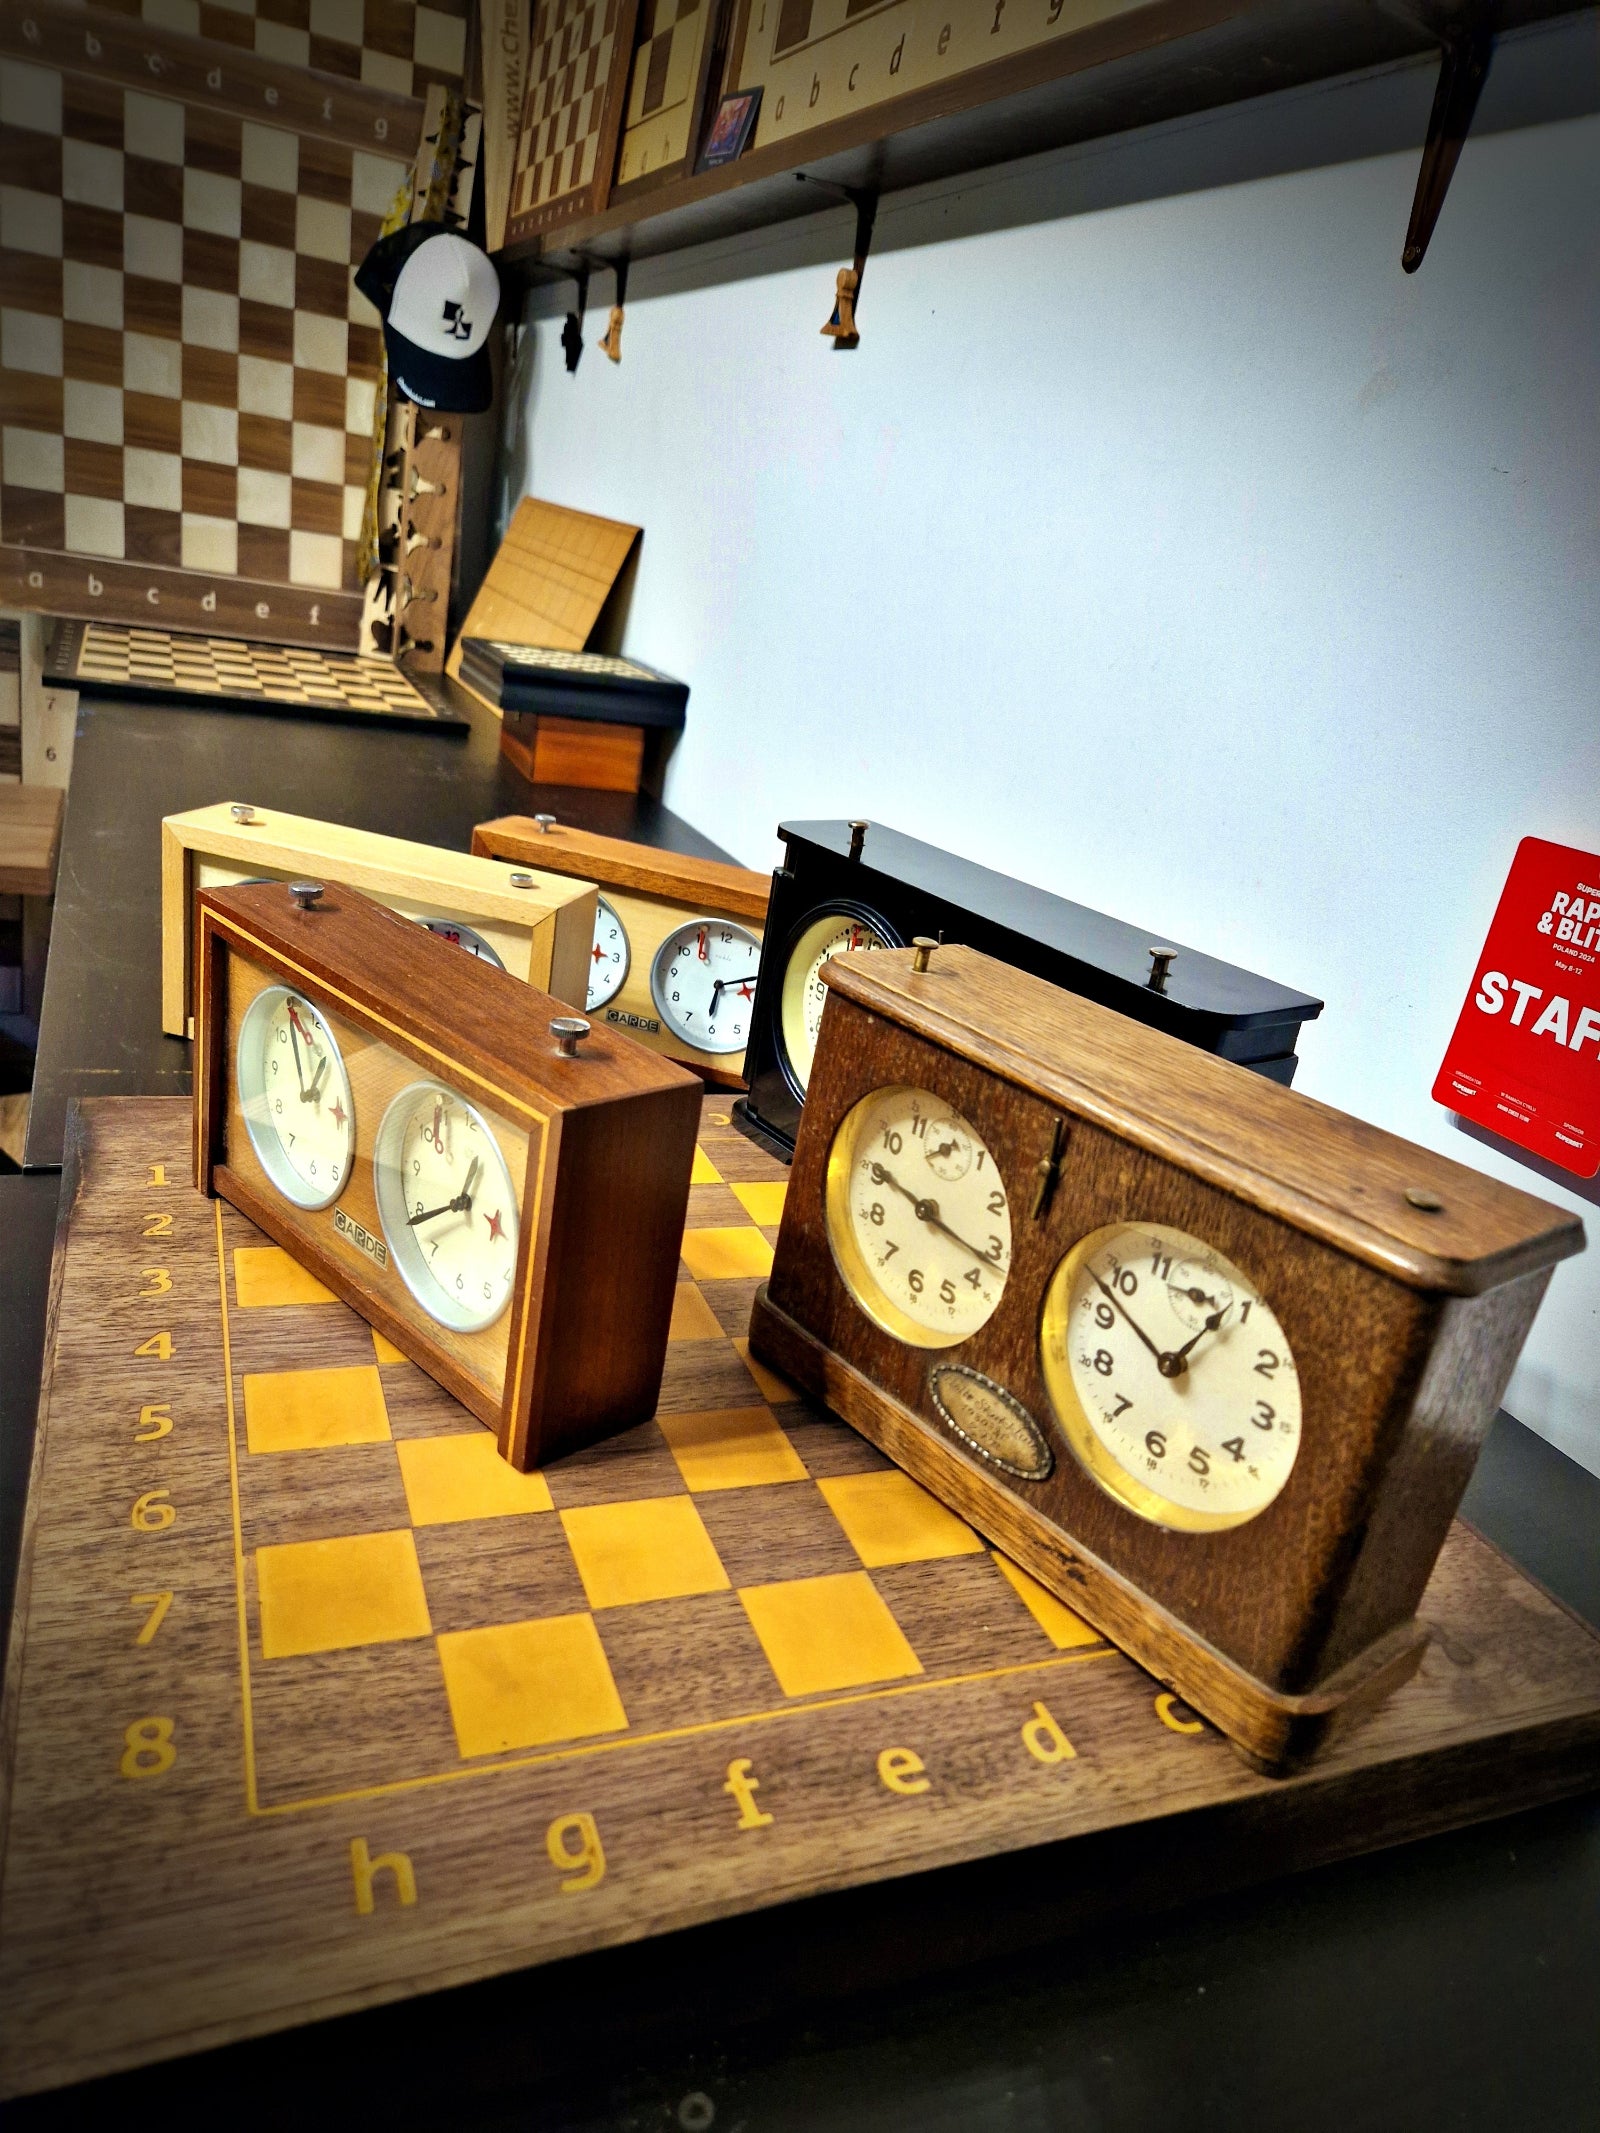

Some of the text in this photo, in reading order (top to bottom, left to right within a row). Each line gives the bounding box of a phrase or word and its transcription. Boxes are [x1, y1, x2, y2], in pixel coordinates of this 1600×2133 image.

[86, 30, 102, 58] b
[207, 65, 223, 90] d
[264, 86, 279, 106] e
[322, 97, 333, 122] f
[374, 117, 389, 140] g
[774, 95, 785, 122] a
[808, 71, 820, 108] b
[848, 62, 860, 91] c
[889, 32, 906, 75] d
[937, 23, 951, 56] e
[28, 571, 321, 626] a b c d e f
[45, 747, 57, 762] 6
[610, 929, 618, 940] 2
[1537, 911, 1554, 936] &
[720, 930, 733, 944] 12
[612, 953, 621, 964] 3
[677, 945, 691, 957] 10
[748, 947, 754, 957] 1
[1552, 942, 1596, 964] POLAND 2024
[670, 967, 678, 978] 9
[1554, 959, 1569, 972] May
[603, 974, 611, 984] 4
[672, 991, 680, 1002] 8
[608, 1009, 660, 1033] GARDE
[685, 1011, 694, 1022] 7
[1475, 970, 1600, 1061] STAF
[275, 1026, 288, 1044] 10
[708, 1024, 716, 1035] 6
[733, 1024, 742, 1035] 5
[271, 1060, 279, 1076] 9
[275, 1098, 283, 1115] 8
[419, 1124, 433, 1143] 10
[911, 1114, 928, 1139] 11
[288, 1132, 296, 1149] 7
[883, 1128, 903, 1155] 10
[309, 1160, 317, 1176] 6
[331, 1164, 339, 1182] 5
[413, 1159, 421, 1177] 9
[976, 1150, 986, 1171] 1
[146, 1164, 171, 1187] 1
[870, 1161, 886, 1186] 9
[869, 1202, 885, 1226] 8
[987, 1190, 1006, 1217] 2
[142, 1213, 173, 1236] 2
[334, 1208, 387, 1267] GARDE
[430, 1240, 439, 1257] 7
[985, 1234, 1004, 1262] 3
[884, 1239, 900, 1262] 7
[963, 1266, 982, 1291] 4
[1151, 1252, 1173, 1281] 11
[138, 1268, 173, 1296] 3
[455, 1273, 464, 1290] 6
[483, 1281, 492, 1300] 5
[908, 1268, 925, 1294] 6
[939, 1278, 957, 1305] 5
[1112, 1266, 1138, 1297] 10
[1094, 1302, 1115, 1330] 9
[1239, 1300, 1252, 1325] 1
[134, 1331, 176, 1360] 4
[1093, 1348, 1115, 1377] 8
[1254, 1349, 1280, 1380] 2
[1112, 1392, 1134, 1418] 7
[1250, 1401, 1276, 1432] 3
[134, 1403, 174, 1442] 5
[1144, 1429, 1168, 1460] 6
[1221, 1436, 1247, 1463] 4
[1187, 1446, 1211, 1476] 5
[130, 1490, 176, 1532] 6
[130, 1590, 174, 1645] 7
[119, 1715, 177, 1779] 8
[349, 1693, 1204, 1915] h g f e d c
